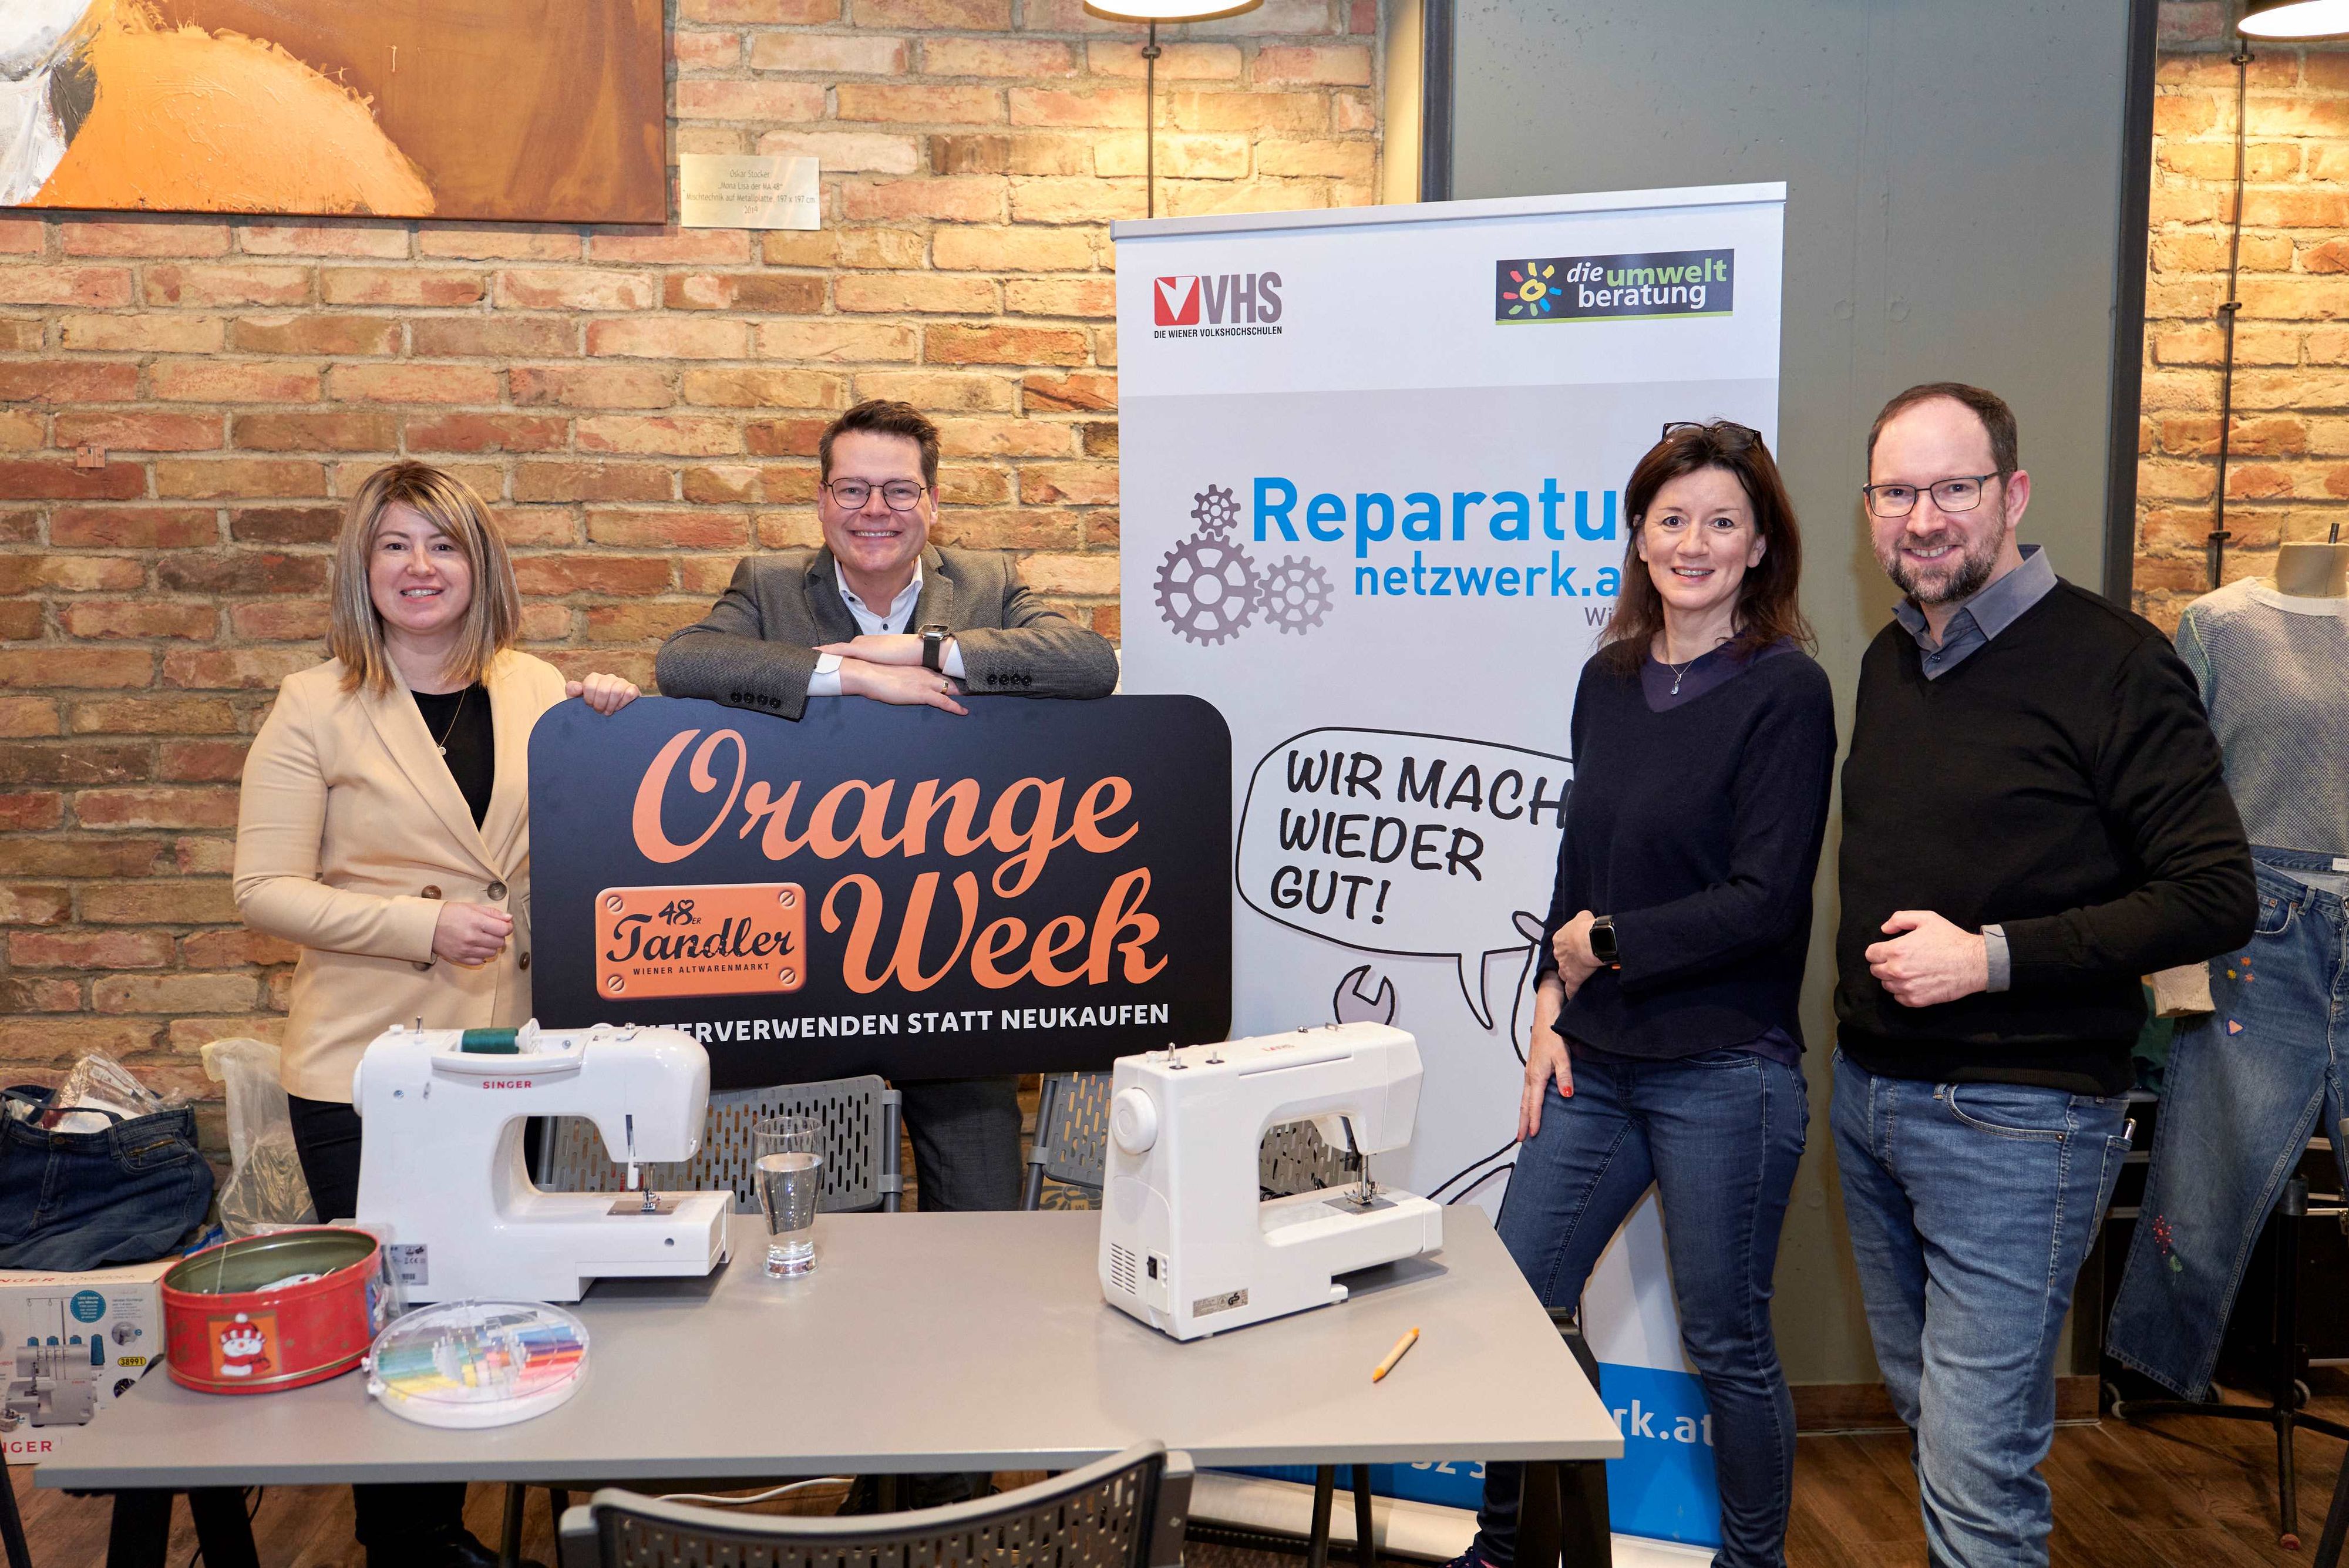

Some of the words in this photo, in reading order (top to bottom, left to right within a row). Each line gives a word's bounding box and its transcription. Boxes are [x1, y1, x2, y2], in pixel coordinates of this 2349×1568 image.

[729, 169, 745, 177] Oskar
[748, 169, 770, 177] Stocker
[686, 193, 723, 201] Mischtechnik
[725, 193, 735, 201] auf
[795, 195, 805, 203] 197
[1566, 261, 1604, 283] die
[1606, 258, 1727, 287] umwelt
[1202, 271, 1282, 324] VHS
[1578, 284, 1706, 309] beratung
[1154, 330, 1166, 339] DIE
[1168, 329, 1197, 338] WIENER
[1200, 326, 1282, 337] VOLKSHOCHSCHULEN
[1253, 477, 1617, 558] Reparatu
[1287, 749, 1382, 800] WIR
[1397, 756, 1573, 829] MACH
[632, 728, 1139, 898] Orange
[1280, 807, 1484, 881] WIEDER
[1270, 864, 1392, 925] GUT!
[606, 913, 795, 962] Tandler
[820, 866, 1169, 994] Week
[633, 967, 673, 975] WIENER
[679, 963, 770, 974] ALTWARENMARKT
[907, 1010, 993, 1034] STATT
[1001, 1004, 1169, 1029] NEUKAUFEN
[483, 1081, 531, 1089] SINGER
